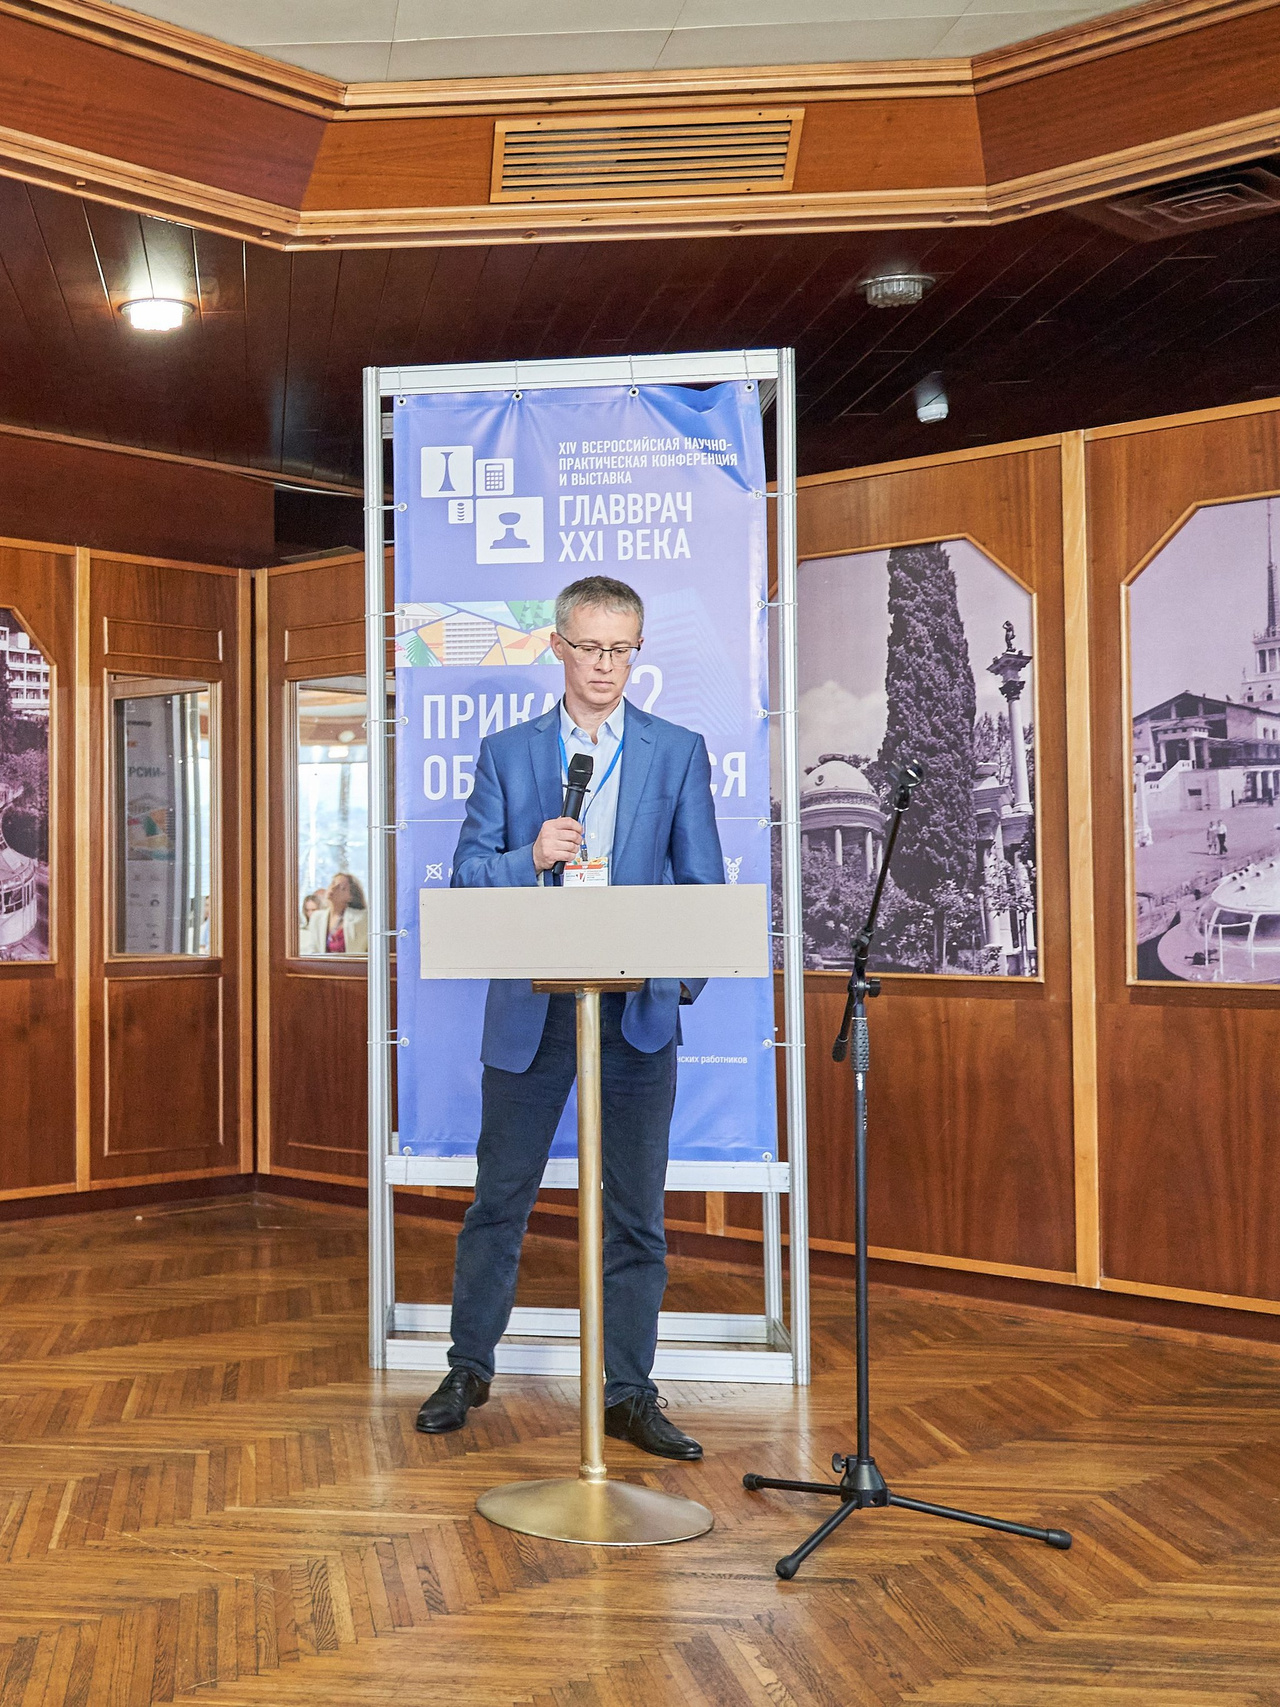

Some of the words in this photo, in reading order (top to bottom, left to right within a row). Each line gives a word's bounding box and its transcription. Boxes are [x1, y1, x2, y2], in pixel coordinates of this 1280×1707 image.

[558, 441, 576, 455] XIV
[582, 436, 680, 454] ВСЕРОССИЙСКАЯ
[684, 436, 733, 452] НАУЧНО-
[559, 454, 647, 471] ПРАКТИЧЕСКАЯ
[651, 452, 738, 468] КОНФЕРЕНЦИЯ
[559, 473, 567, 487] И
[571, 471, 632, 486] ВЫСТАВКА
[559, 491, 692, 526] ГЛАВВРАЧ
[558, 530, 604, 562] XXI
[617, 527, 692, 560] ВЕКА
[701, 1054, 748, 1065] работников
